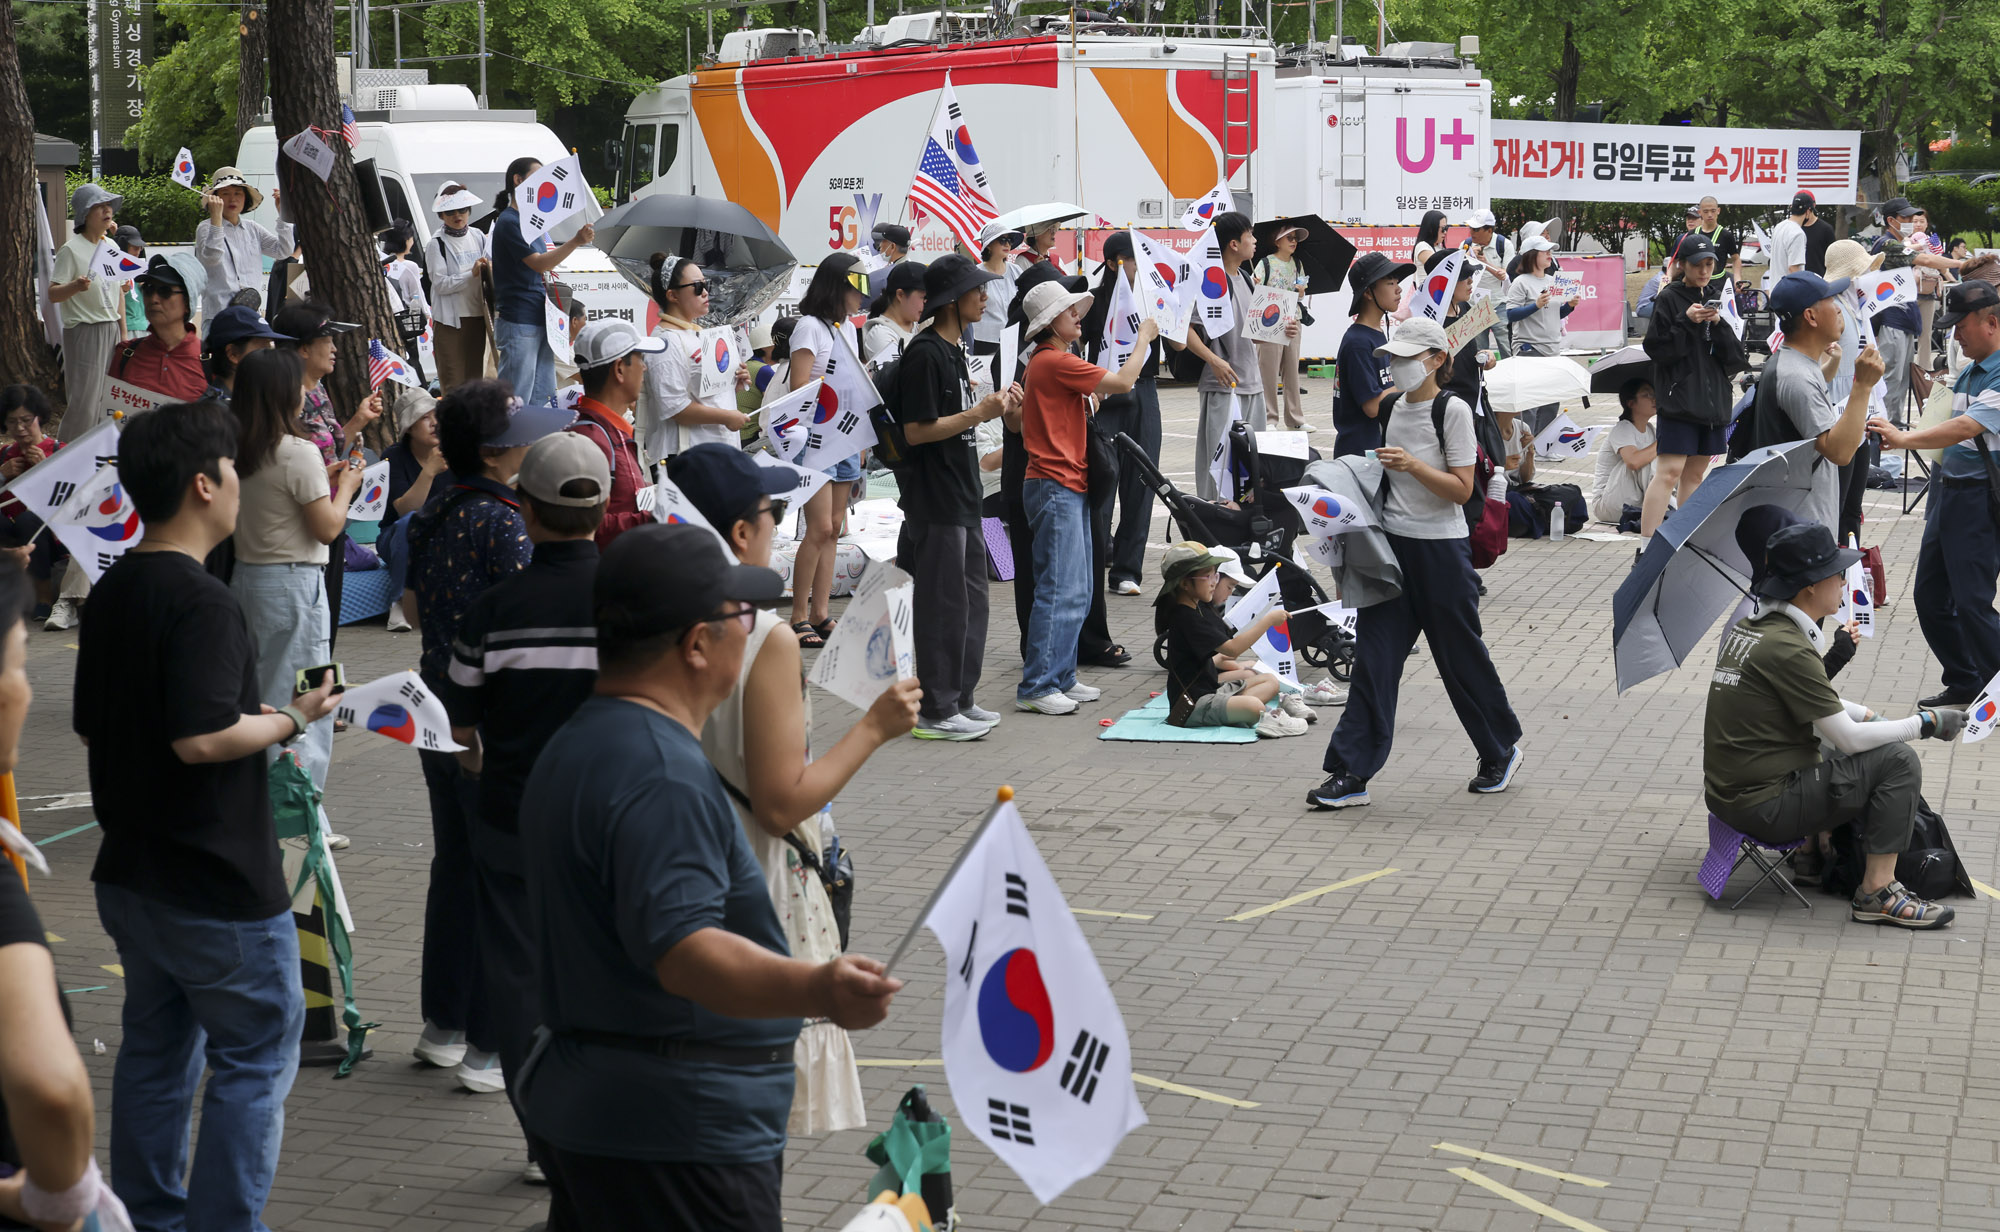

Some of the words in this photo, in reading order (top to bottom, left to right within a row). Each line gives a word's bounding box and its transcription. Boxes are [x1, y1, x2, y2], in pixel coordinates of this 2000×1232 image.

[110, 9, 122, 69] Gymnasium
[1396, 117, 1474, 174] U+
[1492, 138, 1584, 179] 재선거!
[1592, 142, 1696, 182] 당일투표
[1703, 146, 1788, 184] 수개표!
[843, 178, 855, 190] 모든
[1396, 196, 1428, 210] 일상을
[1431, 196, 1474, 210] 심플하게
[1357, 237, 1374, 246] 긴급
[1376, 236, 1400, 246] 서비스
[1395, 250, 1412, 260] 주세
[571, 283, 589, 291] 당신과
[611, 283, 629, 291] 사이에
